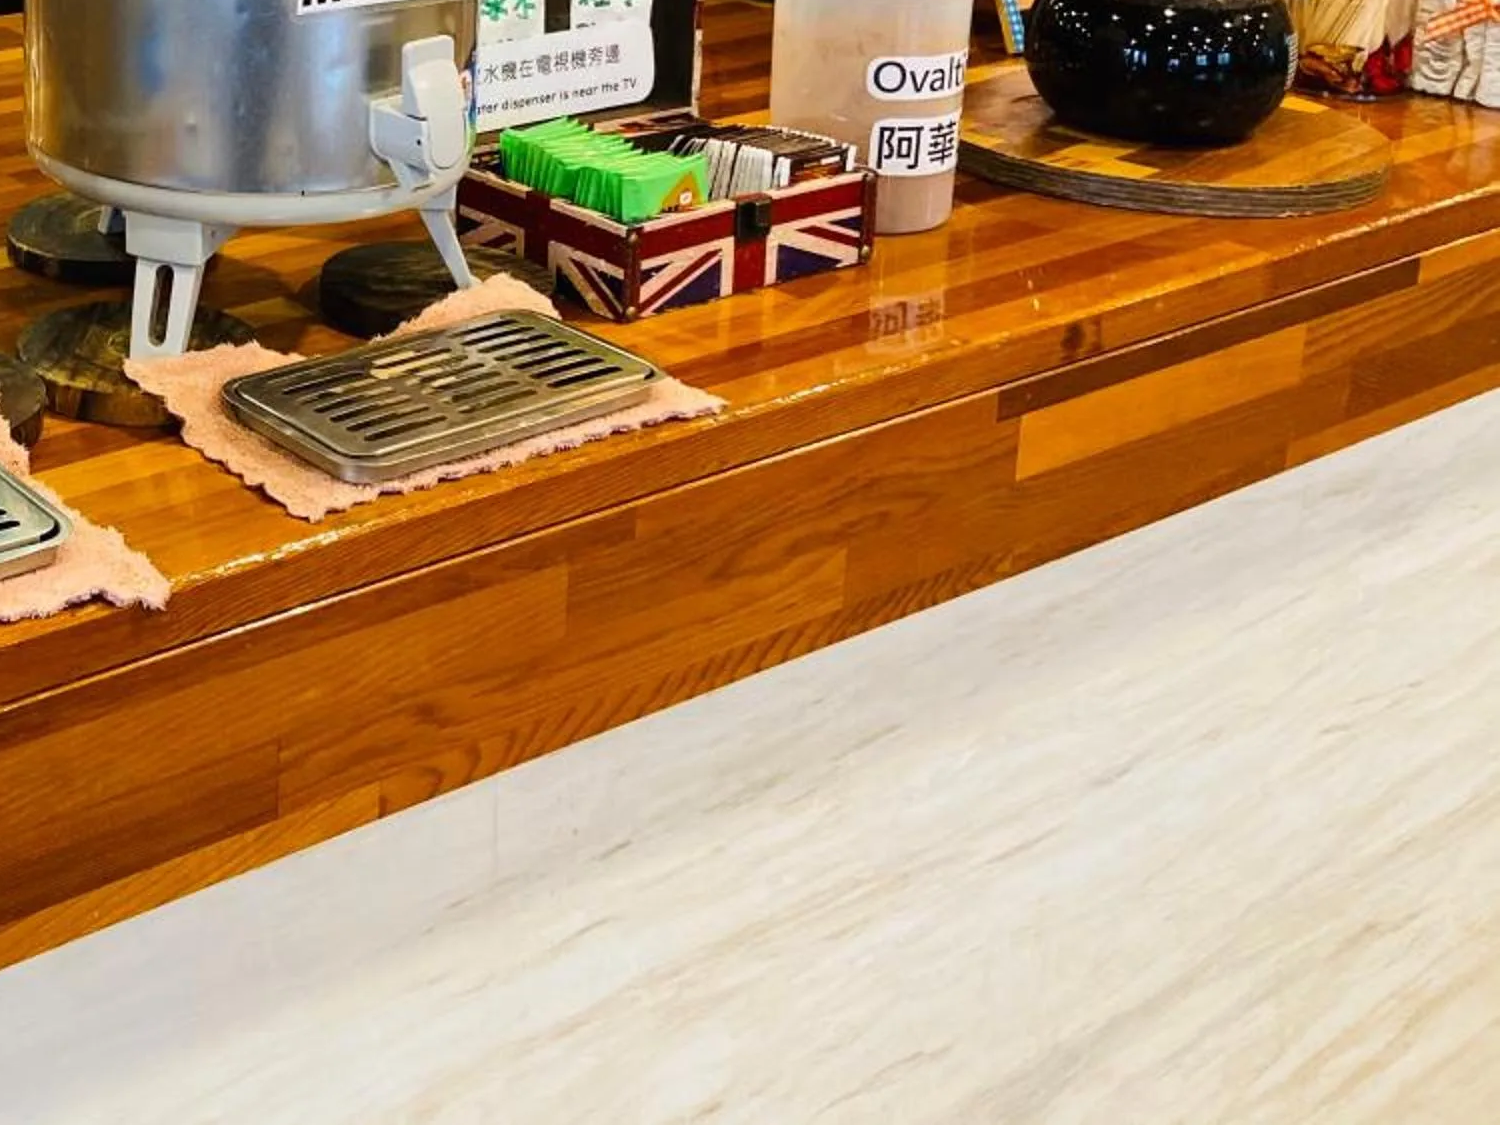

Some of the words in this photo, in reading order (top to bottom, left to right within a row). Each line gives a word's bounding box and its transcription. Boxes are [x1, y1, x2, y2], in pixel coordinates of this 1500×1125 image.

[480, 43, 621, 84] 水機在電視機旁邊
[559, 90, 570, 101] is
[573, 86, 598, 99] near
[601, 81, 619, 94] the
[622, 78, 638, 91] TV
[876, 120, 957, 170] 阿華
